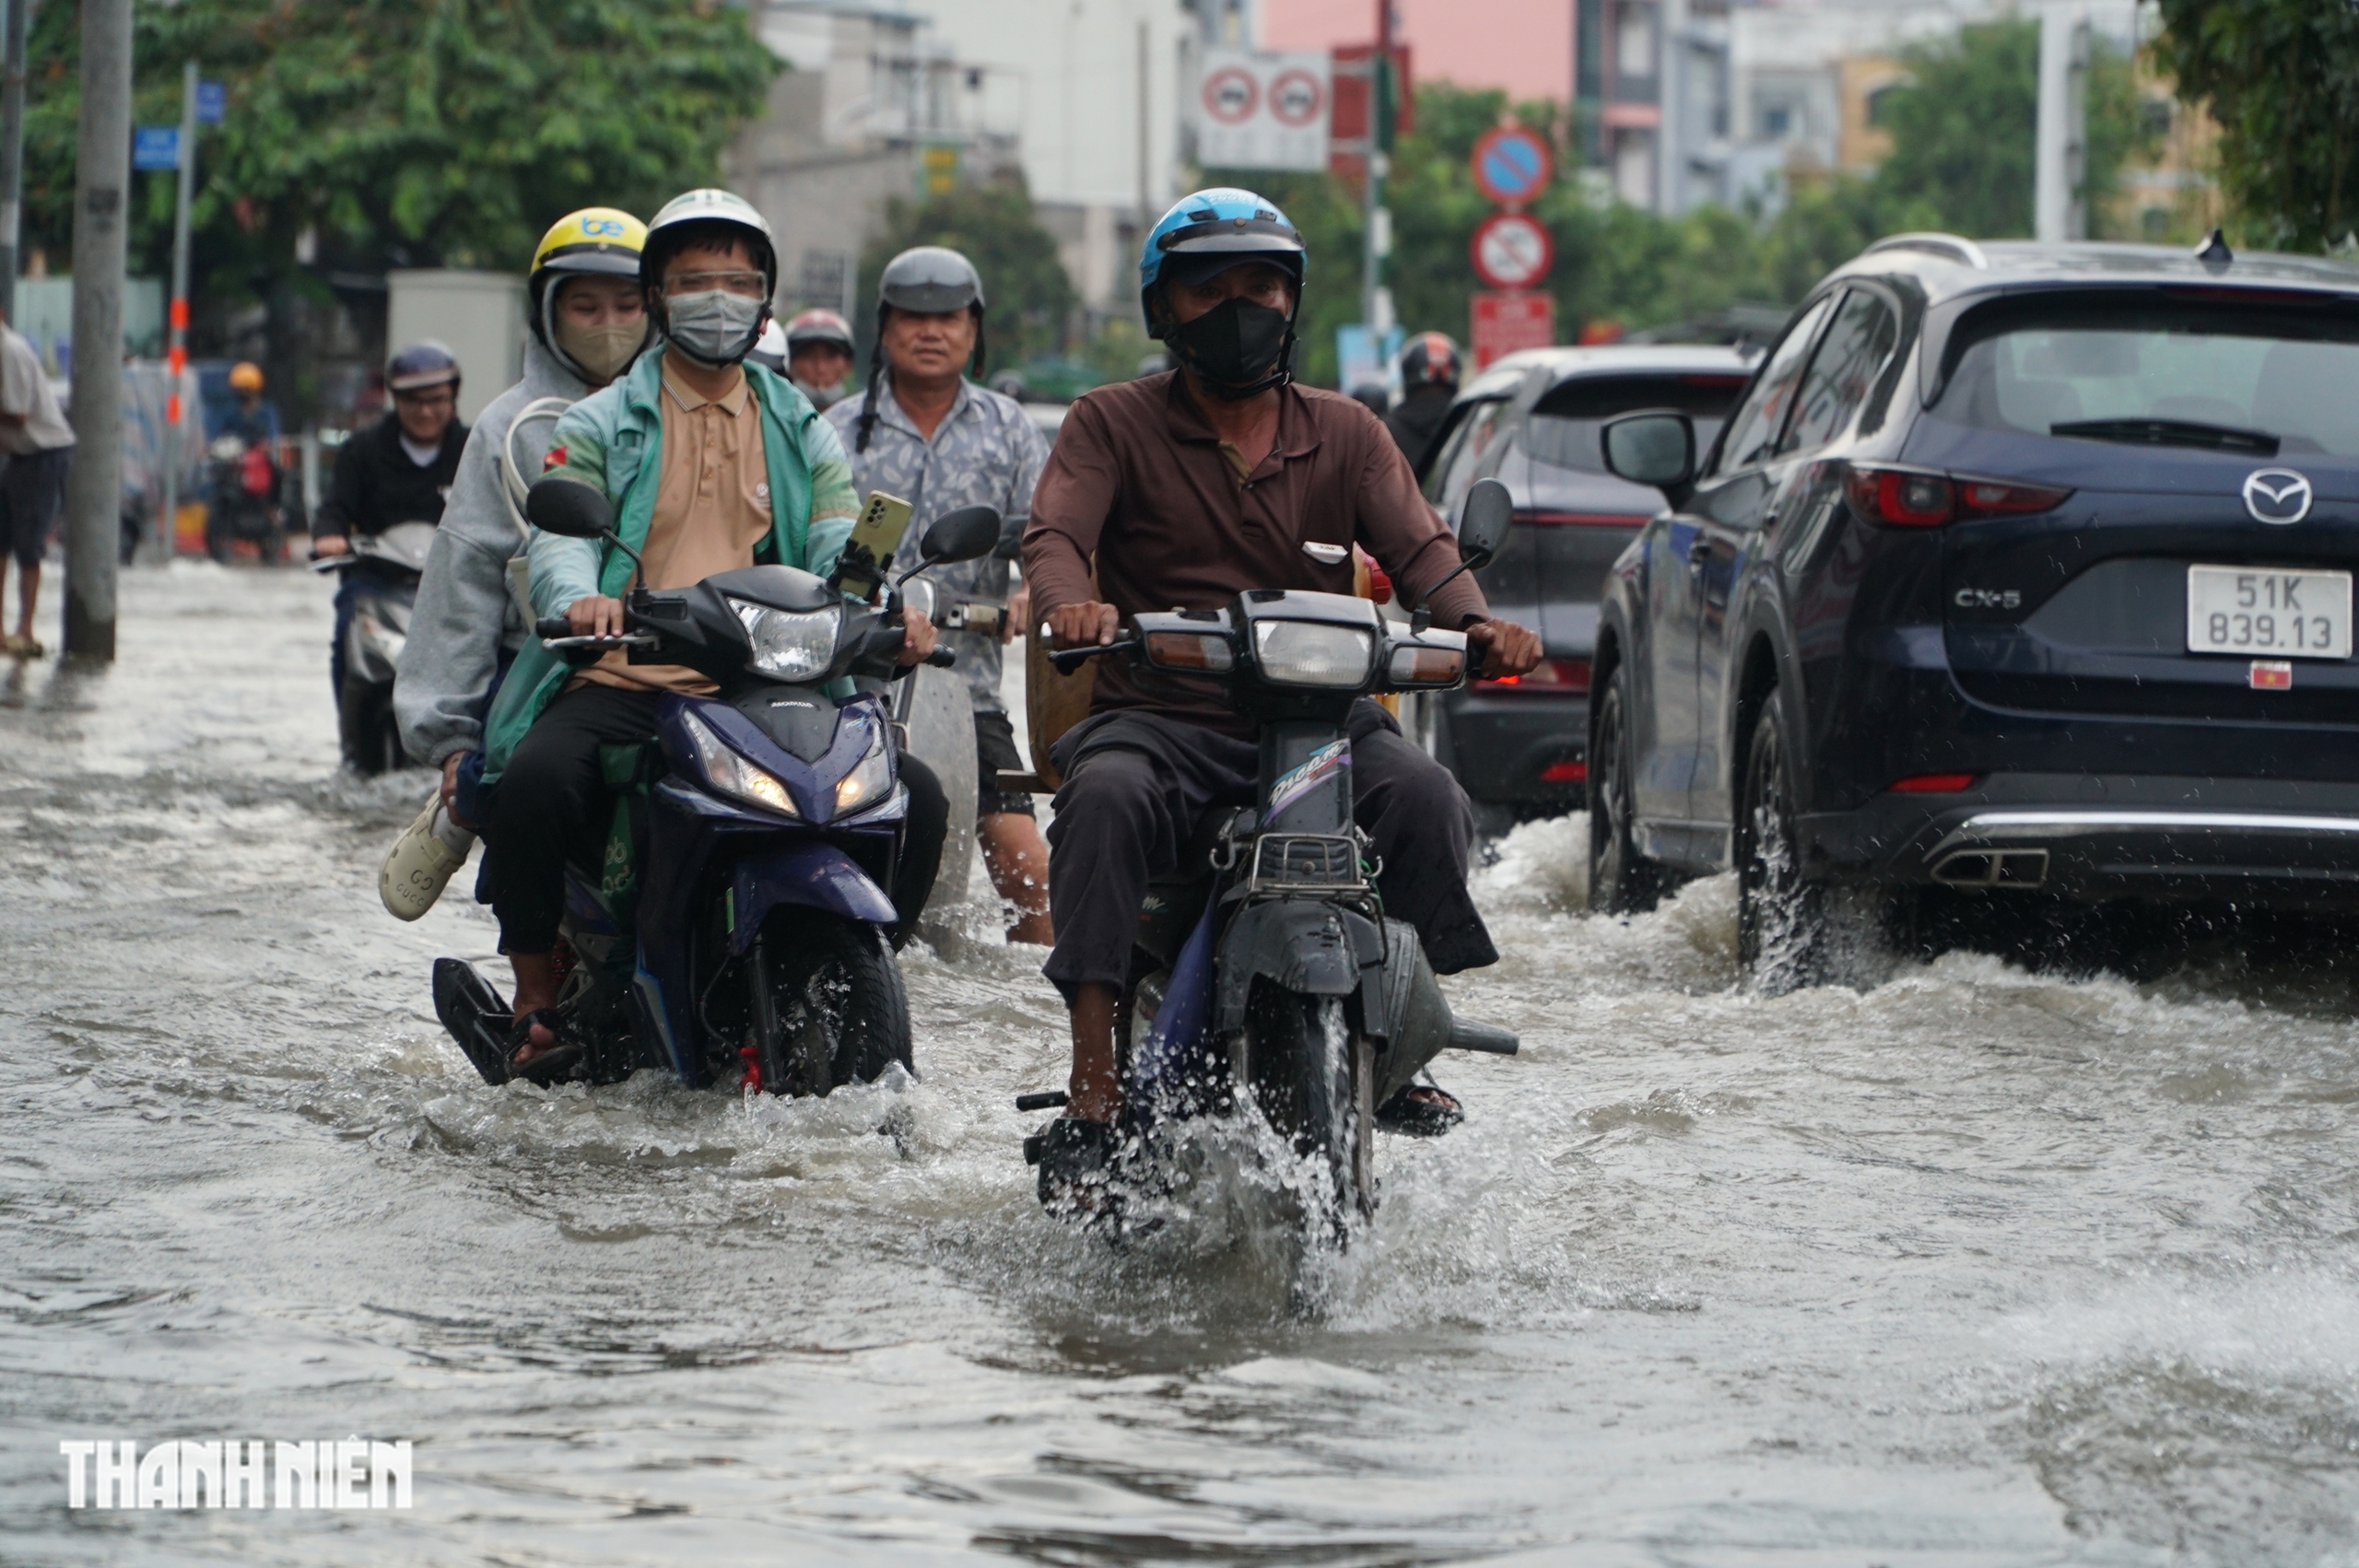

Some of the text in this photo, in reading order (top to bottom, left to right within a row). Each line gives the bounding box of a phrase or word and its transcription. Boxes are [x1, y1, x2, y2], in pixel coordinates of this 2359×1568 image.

[581, 216, 625, 237] be
[1954, 588, 2022, 609] CX-5
[2236, 574, 2302, 610] 51K
[2209, 613, 2331, 649] 839.13
[770, 700, 815, 708] HONDA
[1267, 742, 1345, 806] Dream
